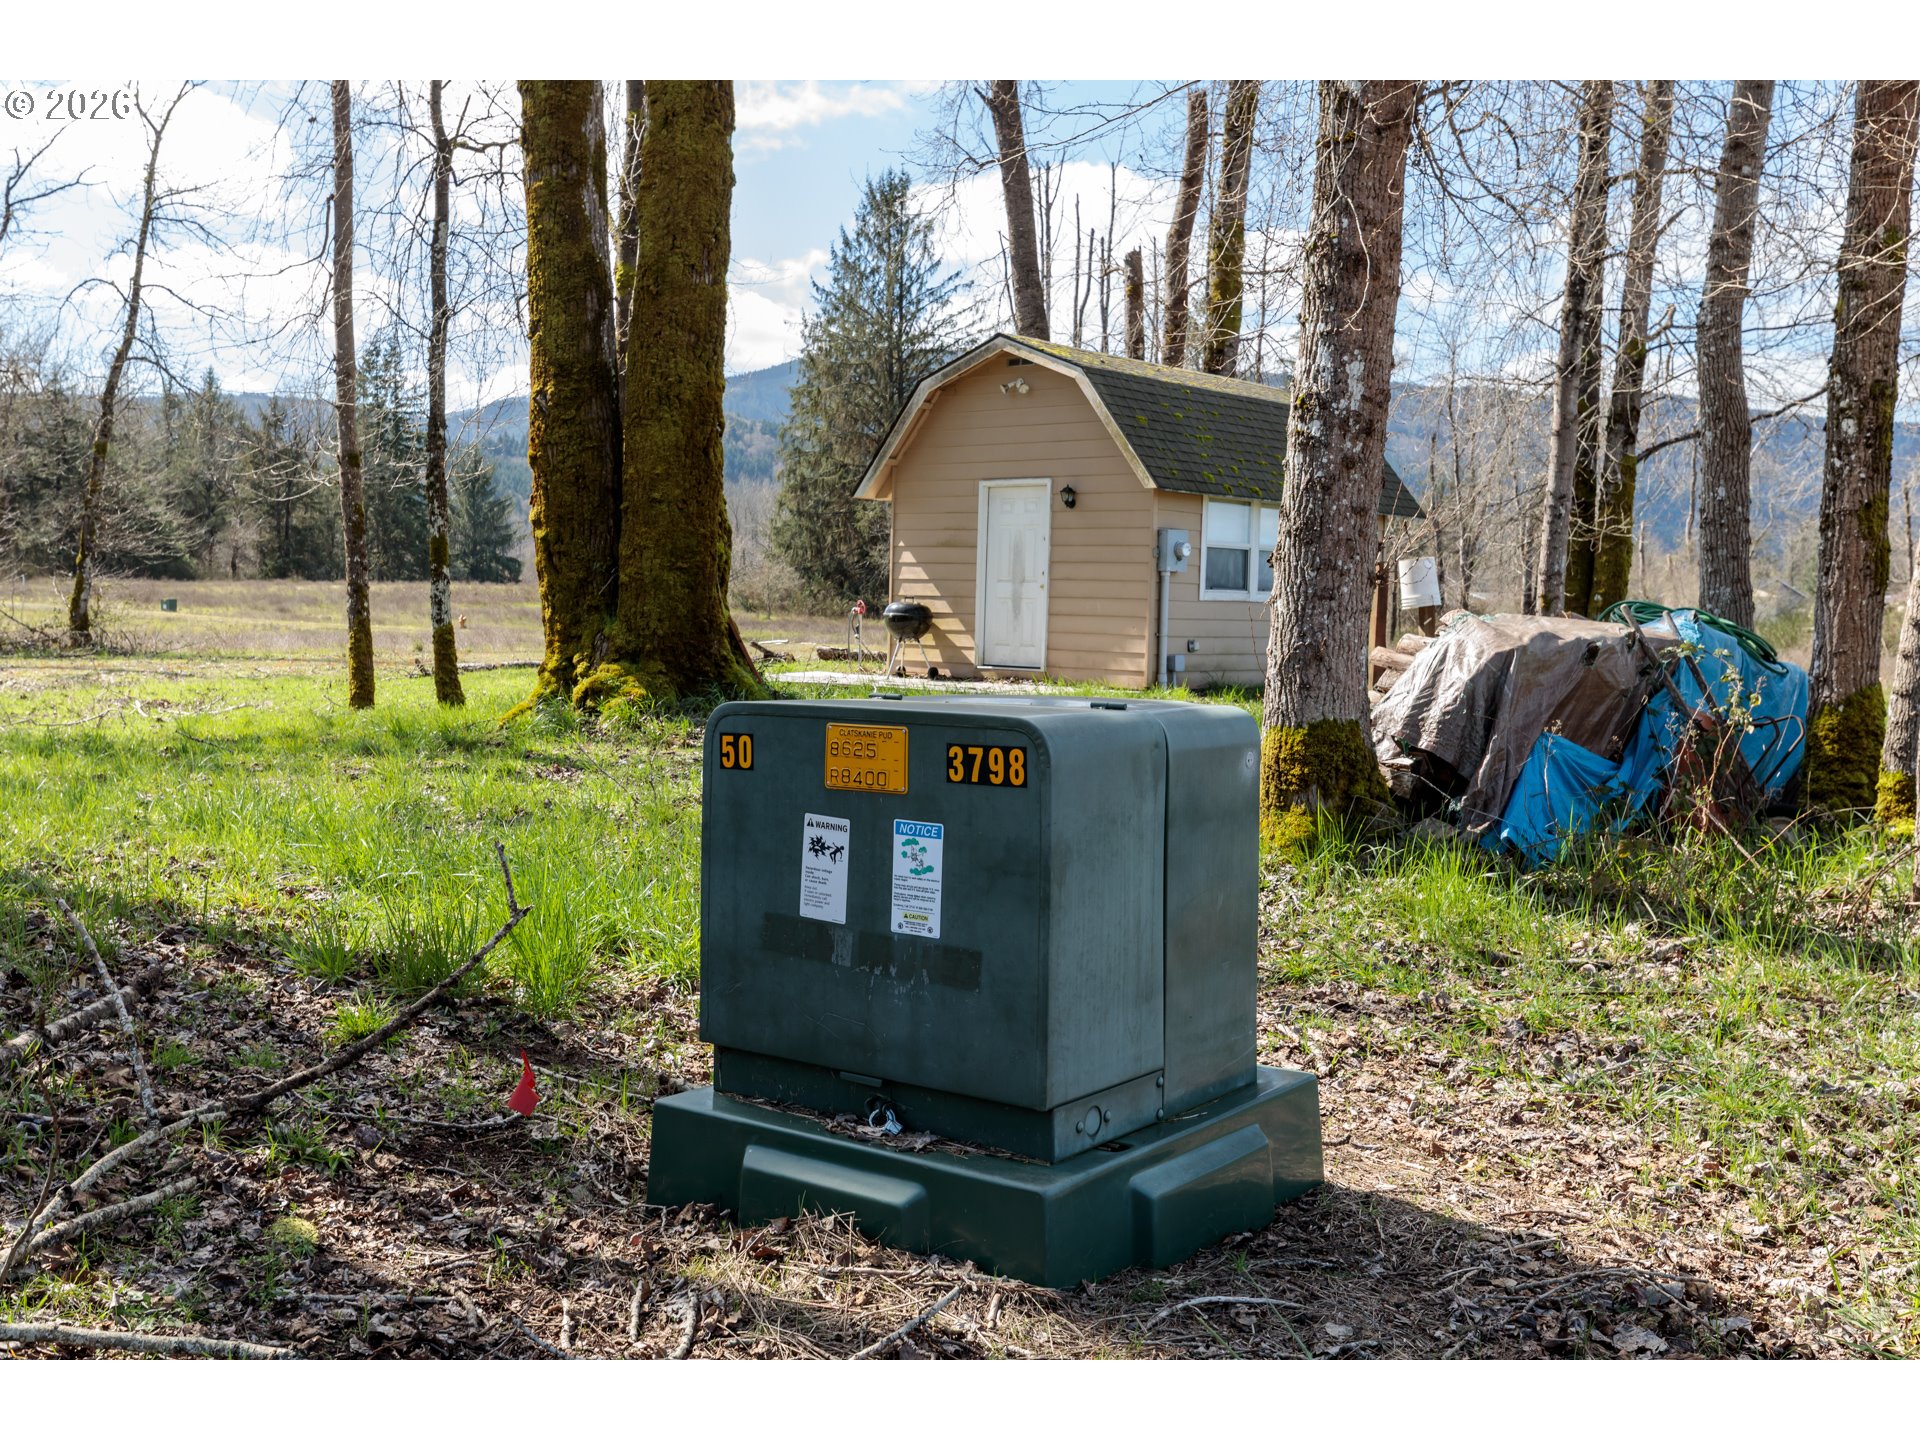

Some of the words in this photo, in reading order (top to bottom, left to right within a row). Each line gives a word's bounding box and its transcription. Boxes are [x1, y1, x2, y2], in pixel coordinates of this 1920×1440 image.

[839, 728, 877, 740] CLATSKANIE
[878, 731, 893, 740] PUD
[721, 735, 752, 769] 50
[830, 740, 877, 759] 8625
[948, 745, 1025, 786] 3798
[830, 768, 888, 787] R8400
[815, 820, 848, 833] WARNING
[899, 823, 938, 837] NOTICE
